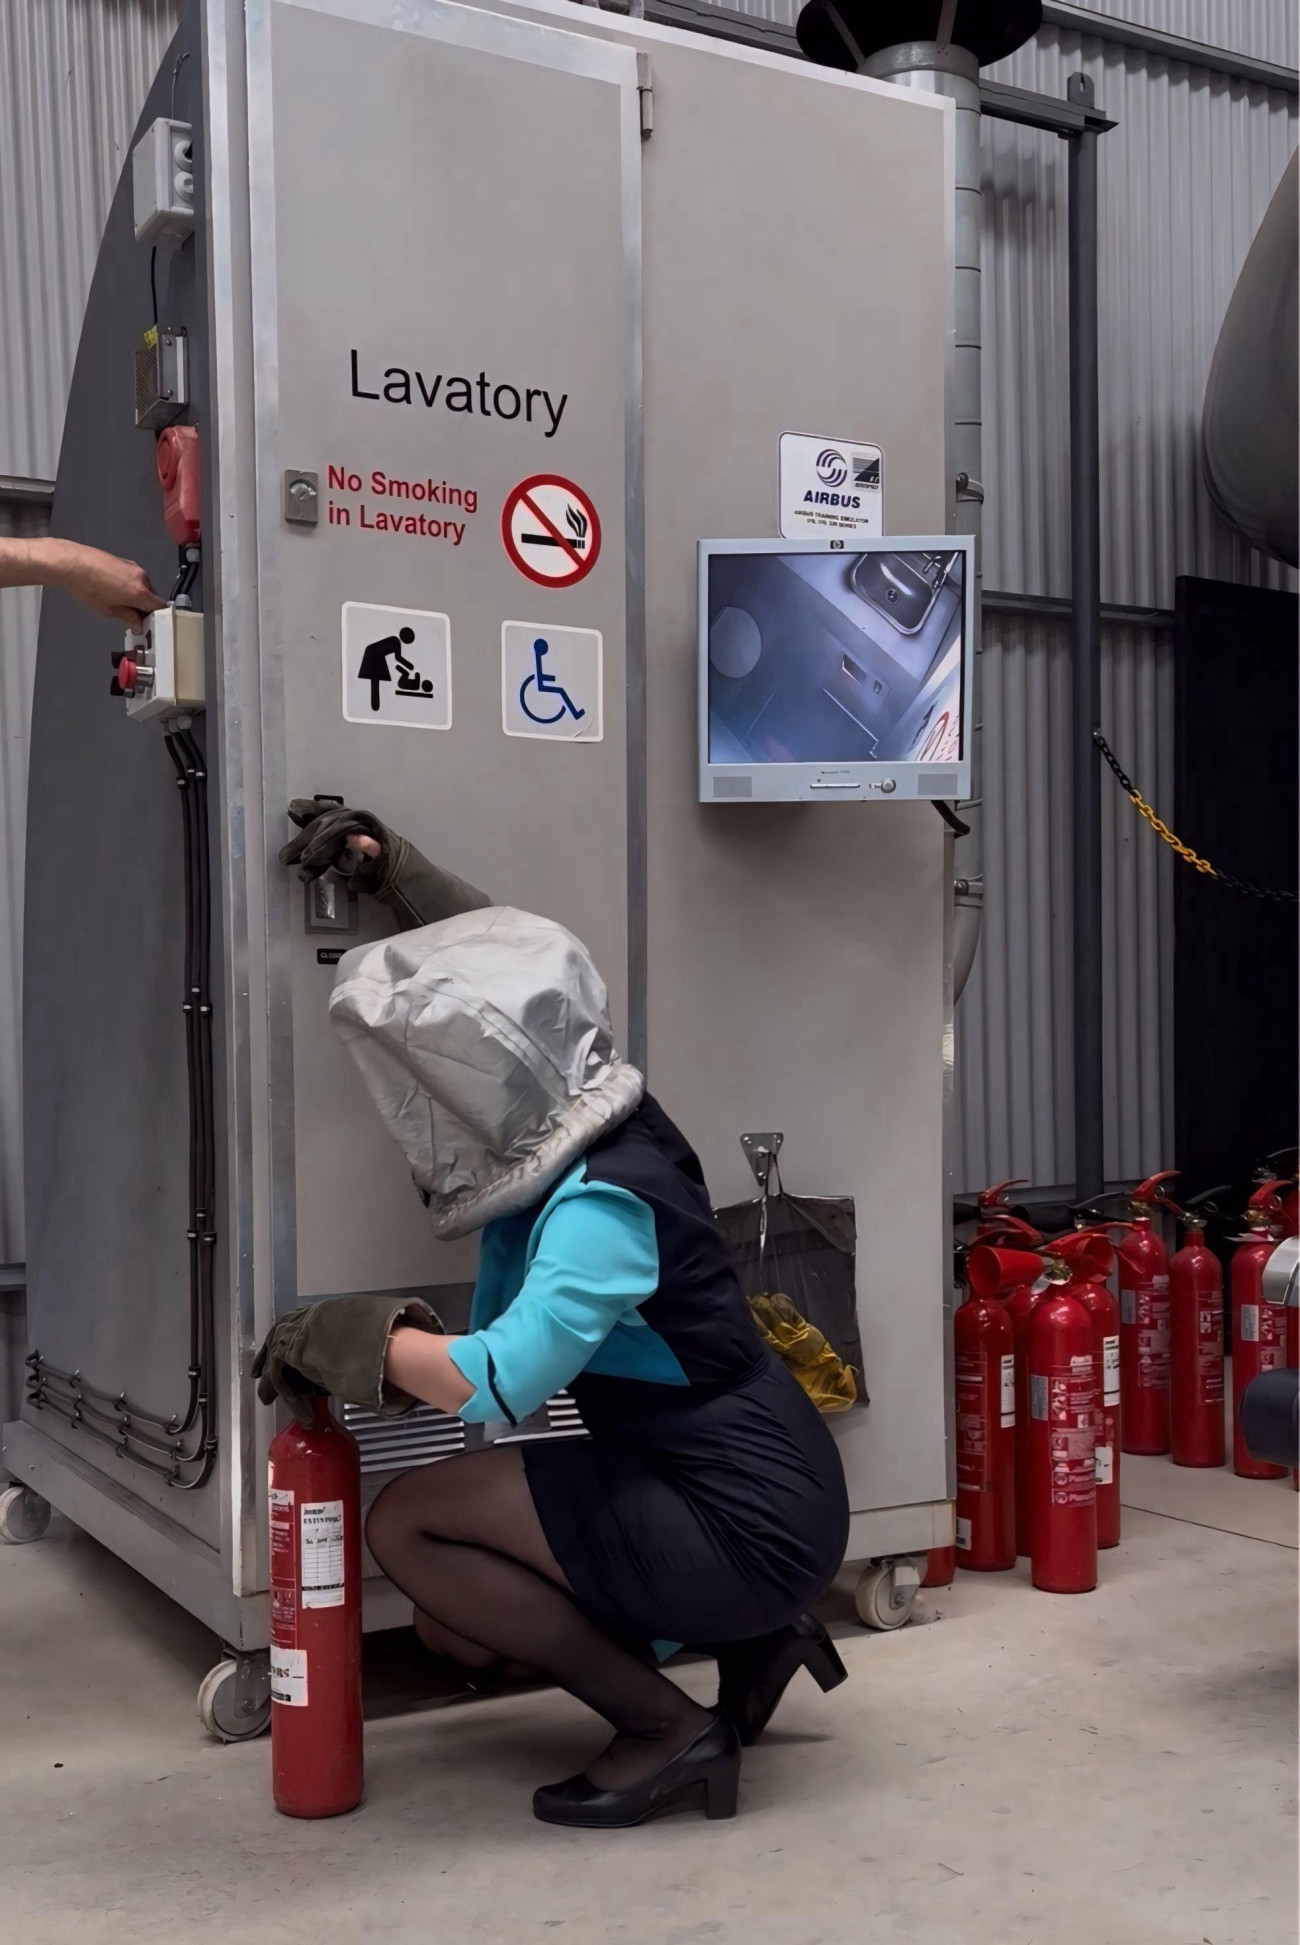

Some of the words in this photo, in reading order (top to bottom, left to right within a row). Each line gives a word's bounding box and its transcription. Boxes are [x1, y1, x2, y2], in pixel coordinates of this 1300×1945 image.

[350, 349, 568, 438] Lavatory
[328, 464, 362, 493] No
[371, 471, 478, 513] Smoking
[803, 490, 861, 509] AIRBUS
[328, 501, 351, 527] in
[360, 504, 466, 546] Lavatory
